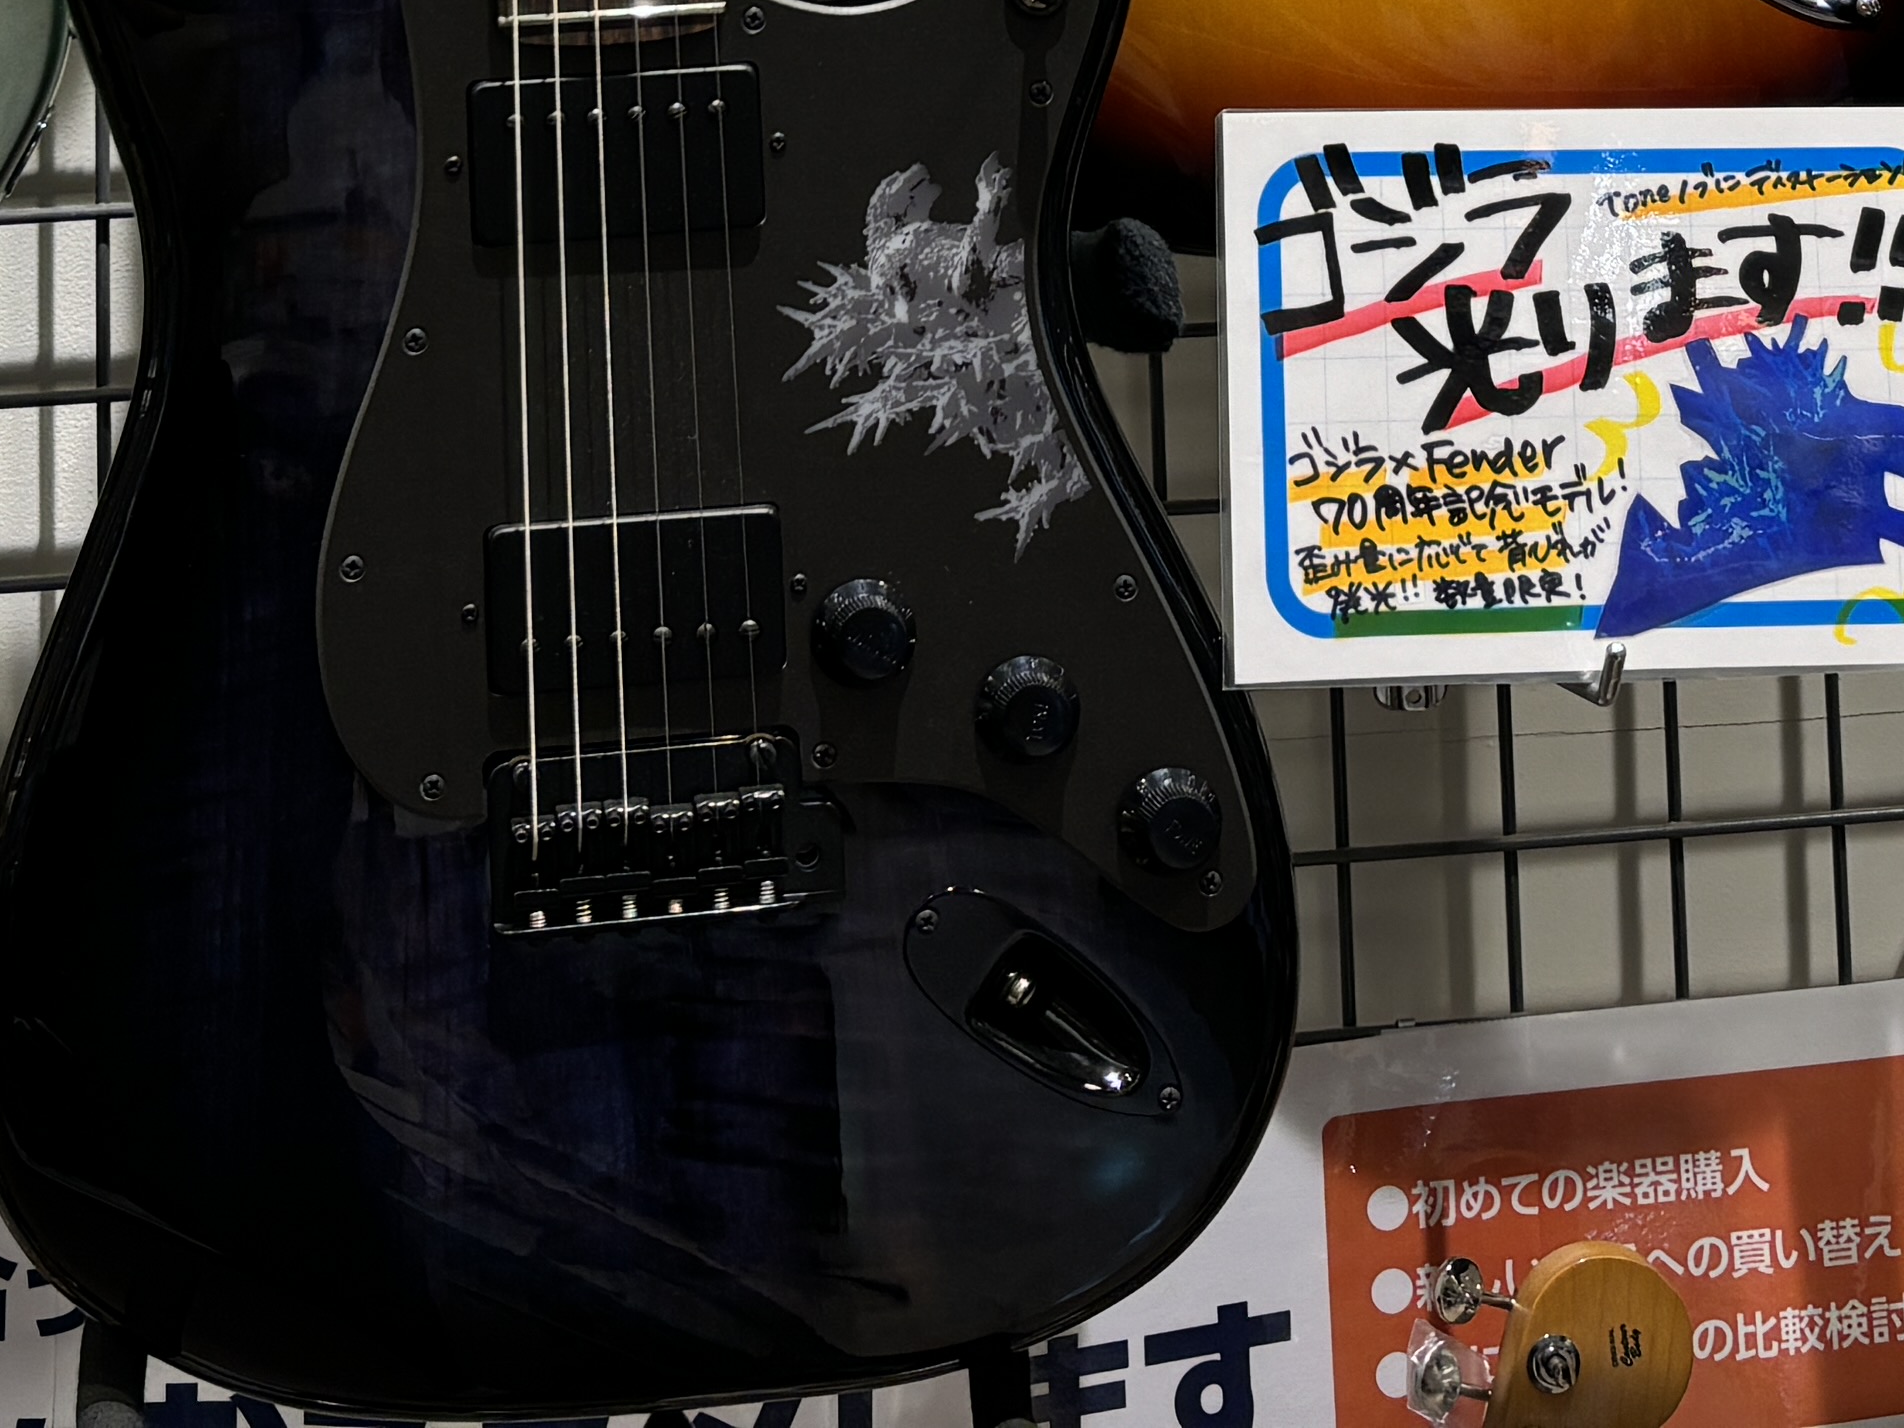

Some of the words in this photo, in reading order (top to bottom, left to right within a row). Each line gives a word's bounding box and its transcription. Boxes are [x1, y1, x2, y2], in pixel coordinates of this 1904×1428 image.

[1255, 143, 1571, 335] ゴジラ
[1412, 1148, 1770, 1228] 初めての楽器購入
